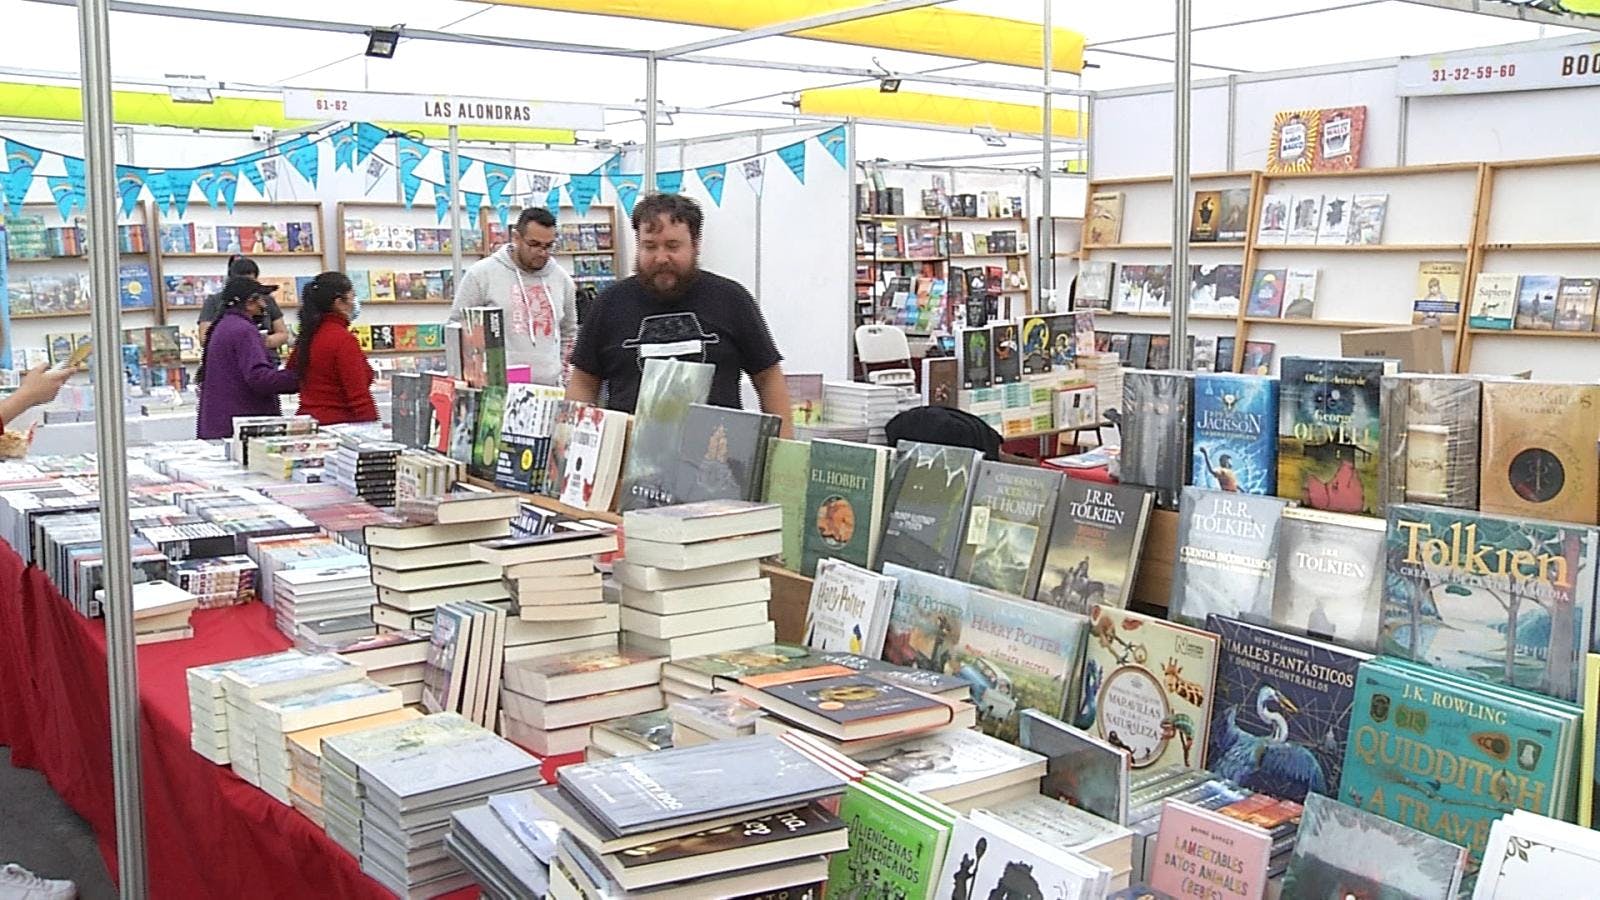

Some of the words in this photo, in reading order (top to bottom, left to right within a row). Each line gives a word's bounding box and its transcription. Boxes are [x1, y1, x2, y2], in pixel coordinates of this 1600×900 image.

[1432, 64, 1516, 82] 31-32-59-60
[316, 99, 348, 111] 61-62
[424, 101, 451, 118] LAS
[458, 103, 531, 121] ALONDRAS
[1196, 410, 1263, 434] JACKSON
[811, 468, 826, 484] EL
[826, 470, 867, 490] HOBBIT
[1084, 488, 1116, 508] J.R.R.
[1212, 499, 1253, 519] J.R.R.
[1069, 501, 1126, 525] TOLKIEN
[1191, 513, 1267, 540] TOLKIEN
[1296, 551, 1367, 578] TOLKIEN
[1396, 519, 1573, 588] Tolkien
[1014, 626, 1063, 657] POTTER
[1263, 665, 1330, 694] ENCONTRARLOS
[1272, 653, 1355, 689] FANTÁSTICOS
[1402, 683, 1428, 703] J.K.
[1431, 692, 1508, 726] ROWLING
[1355, 725, 1546, 814] QUIDDITCH
[1396, 792, 1491, 852] TRAVÉ
[1164, 852, 1197, 875] DATOS
